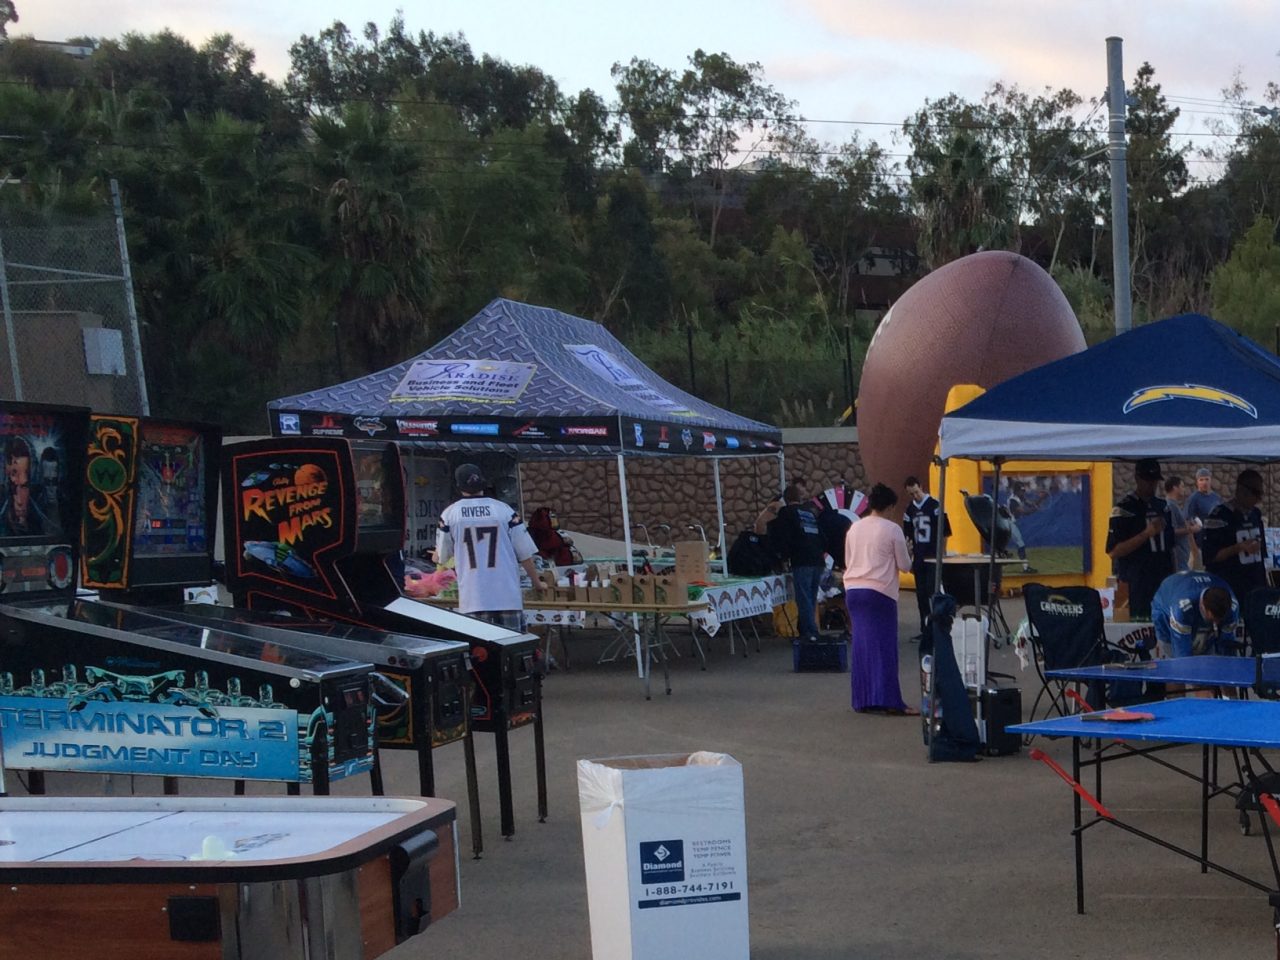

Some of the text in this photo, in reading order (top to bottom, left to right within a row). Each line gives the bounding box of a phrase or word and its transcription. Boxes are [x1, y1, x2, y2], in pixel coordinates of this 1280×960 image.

[453, 384, 510, 393] Solutions
[461, 379, 486, 387] and
[487, 380, 519, 389] Fleet
[242, 480, 328, 524] REVENGE
[289, 498, 321, 516] FROM
[461, 505, 491, 518] RIVERS
[278, 507, 333, 545] MARS
[463, 525, 499, 570] 17
[1040, 601, 1084, 614] CHARGERS
[0, 707, 288, 742] TERMINATOR 2
[22, 741, 258, 769] JUDGMENT DAY
[643, 860, 682, 870] Diamond
[645, 881, 734, 897] 1-888-744-7191
